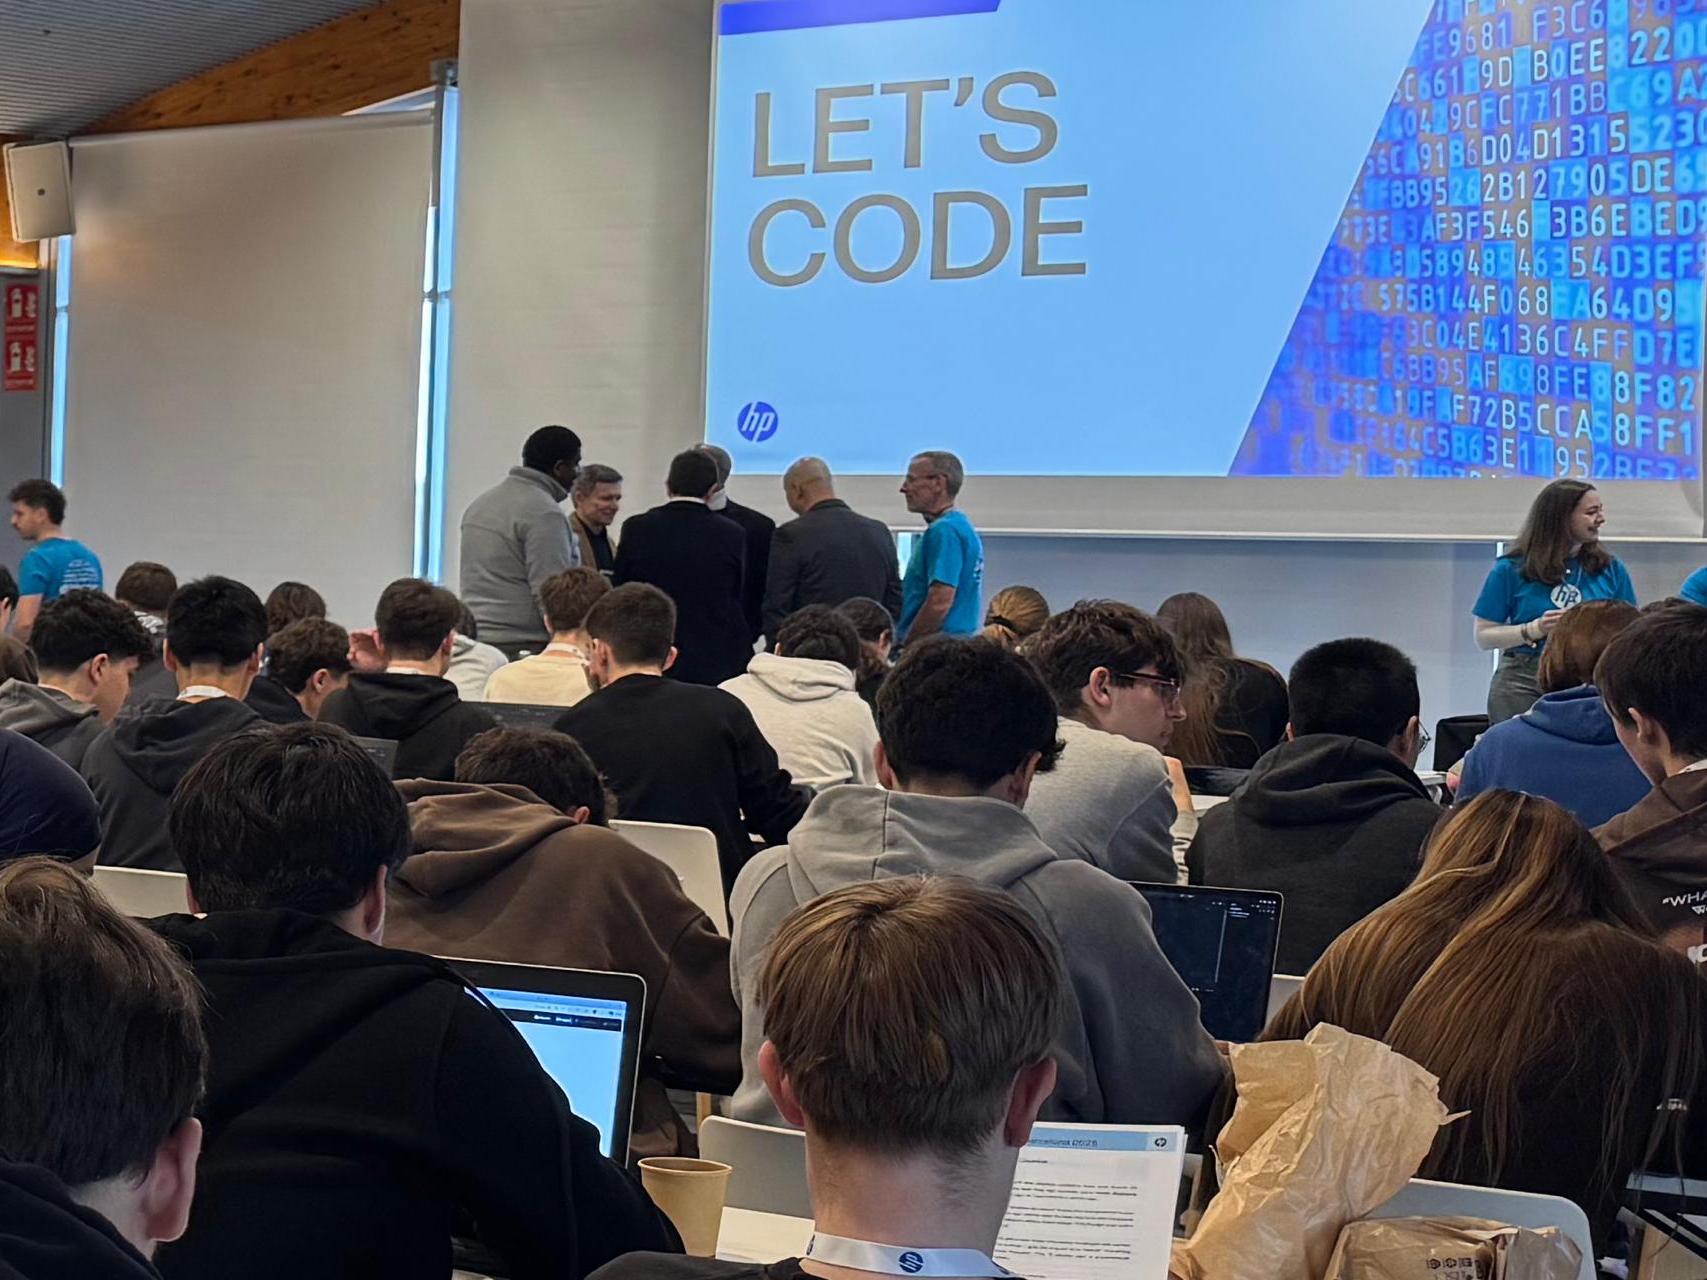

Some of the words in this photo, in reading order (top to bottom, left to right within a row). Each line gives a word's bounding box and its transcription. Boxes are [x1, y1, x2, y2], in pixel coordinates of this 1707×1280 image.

[752, 70, 1059, 178] LET'S
[747, 184, 1089, 288] CODE
[737, 401, 779, 442] hp
[898, 1251, 924, 1274] hp
